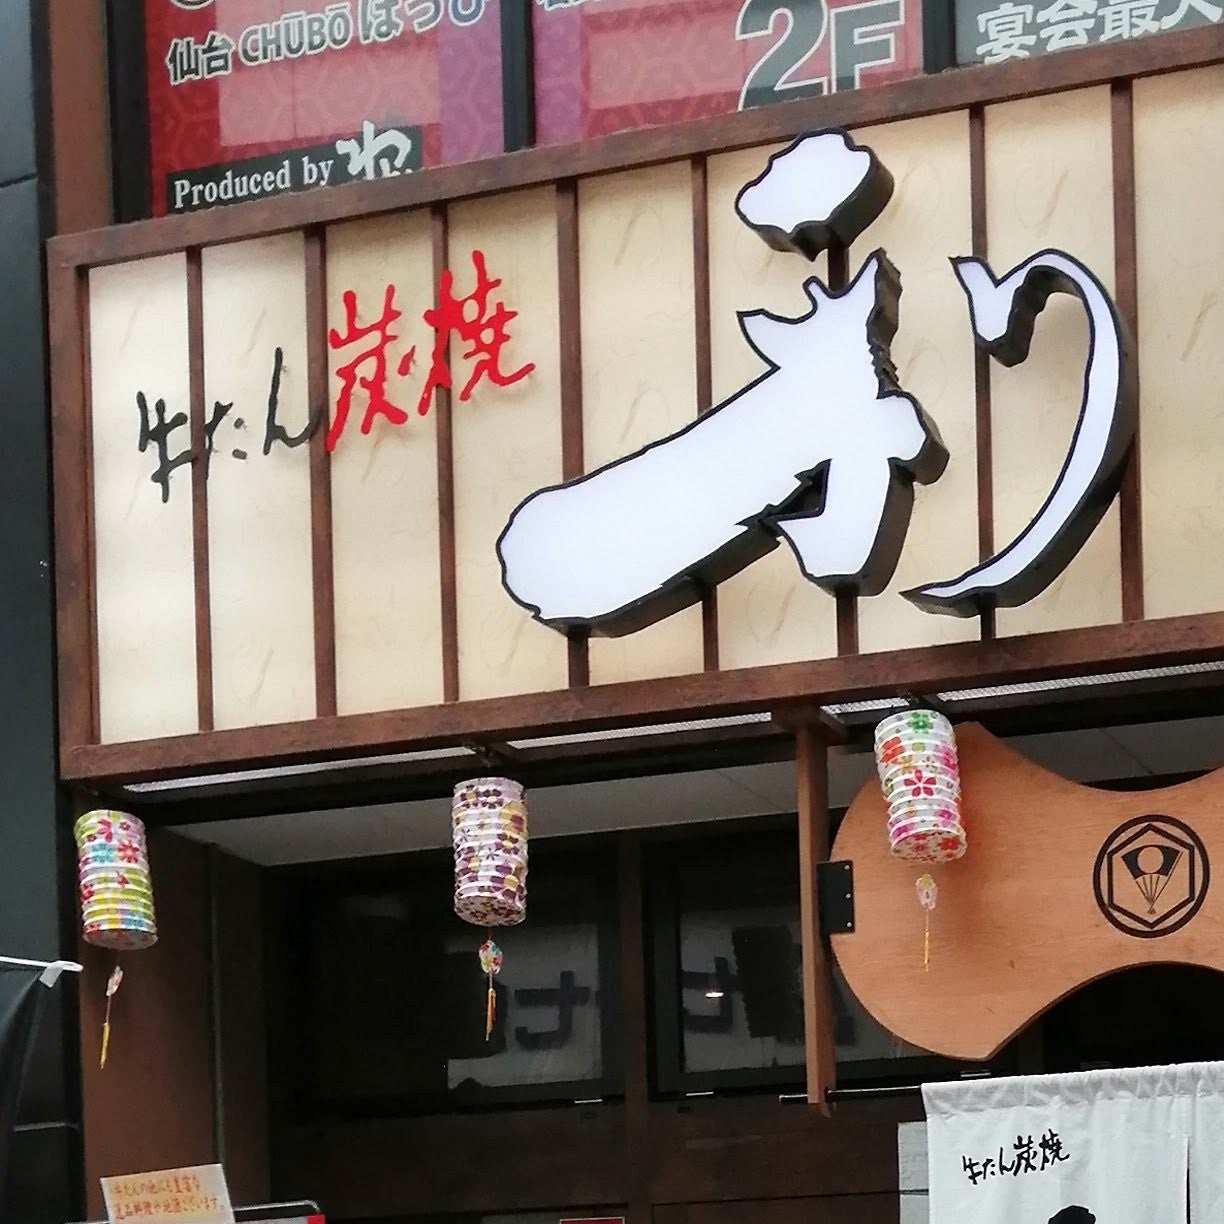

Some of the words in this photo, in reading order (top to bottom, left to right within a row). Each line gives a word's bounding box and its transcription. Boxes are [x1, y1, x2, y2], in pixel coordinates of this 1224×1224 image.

[166, 33, 234, 84] 仙台
[734, 0, 904, 113] 2F
[173, 159, 292, 209] Produced
[302, 157, 335, 189] by
[136, 250, 536, 502] 牛たん炭焼
[963, 1128, 1070, 1185] 牛たん炭焼
